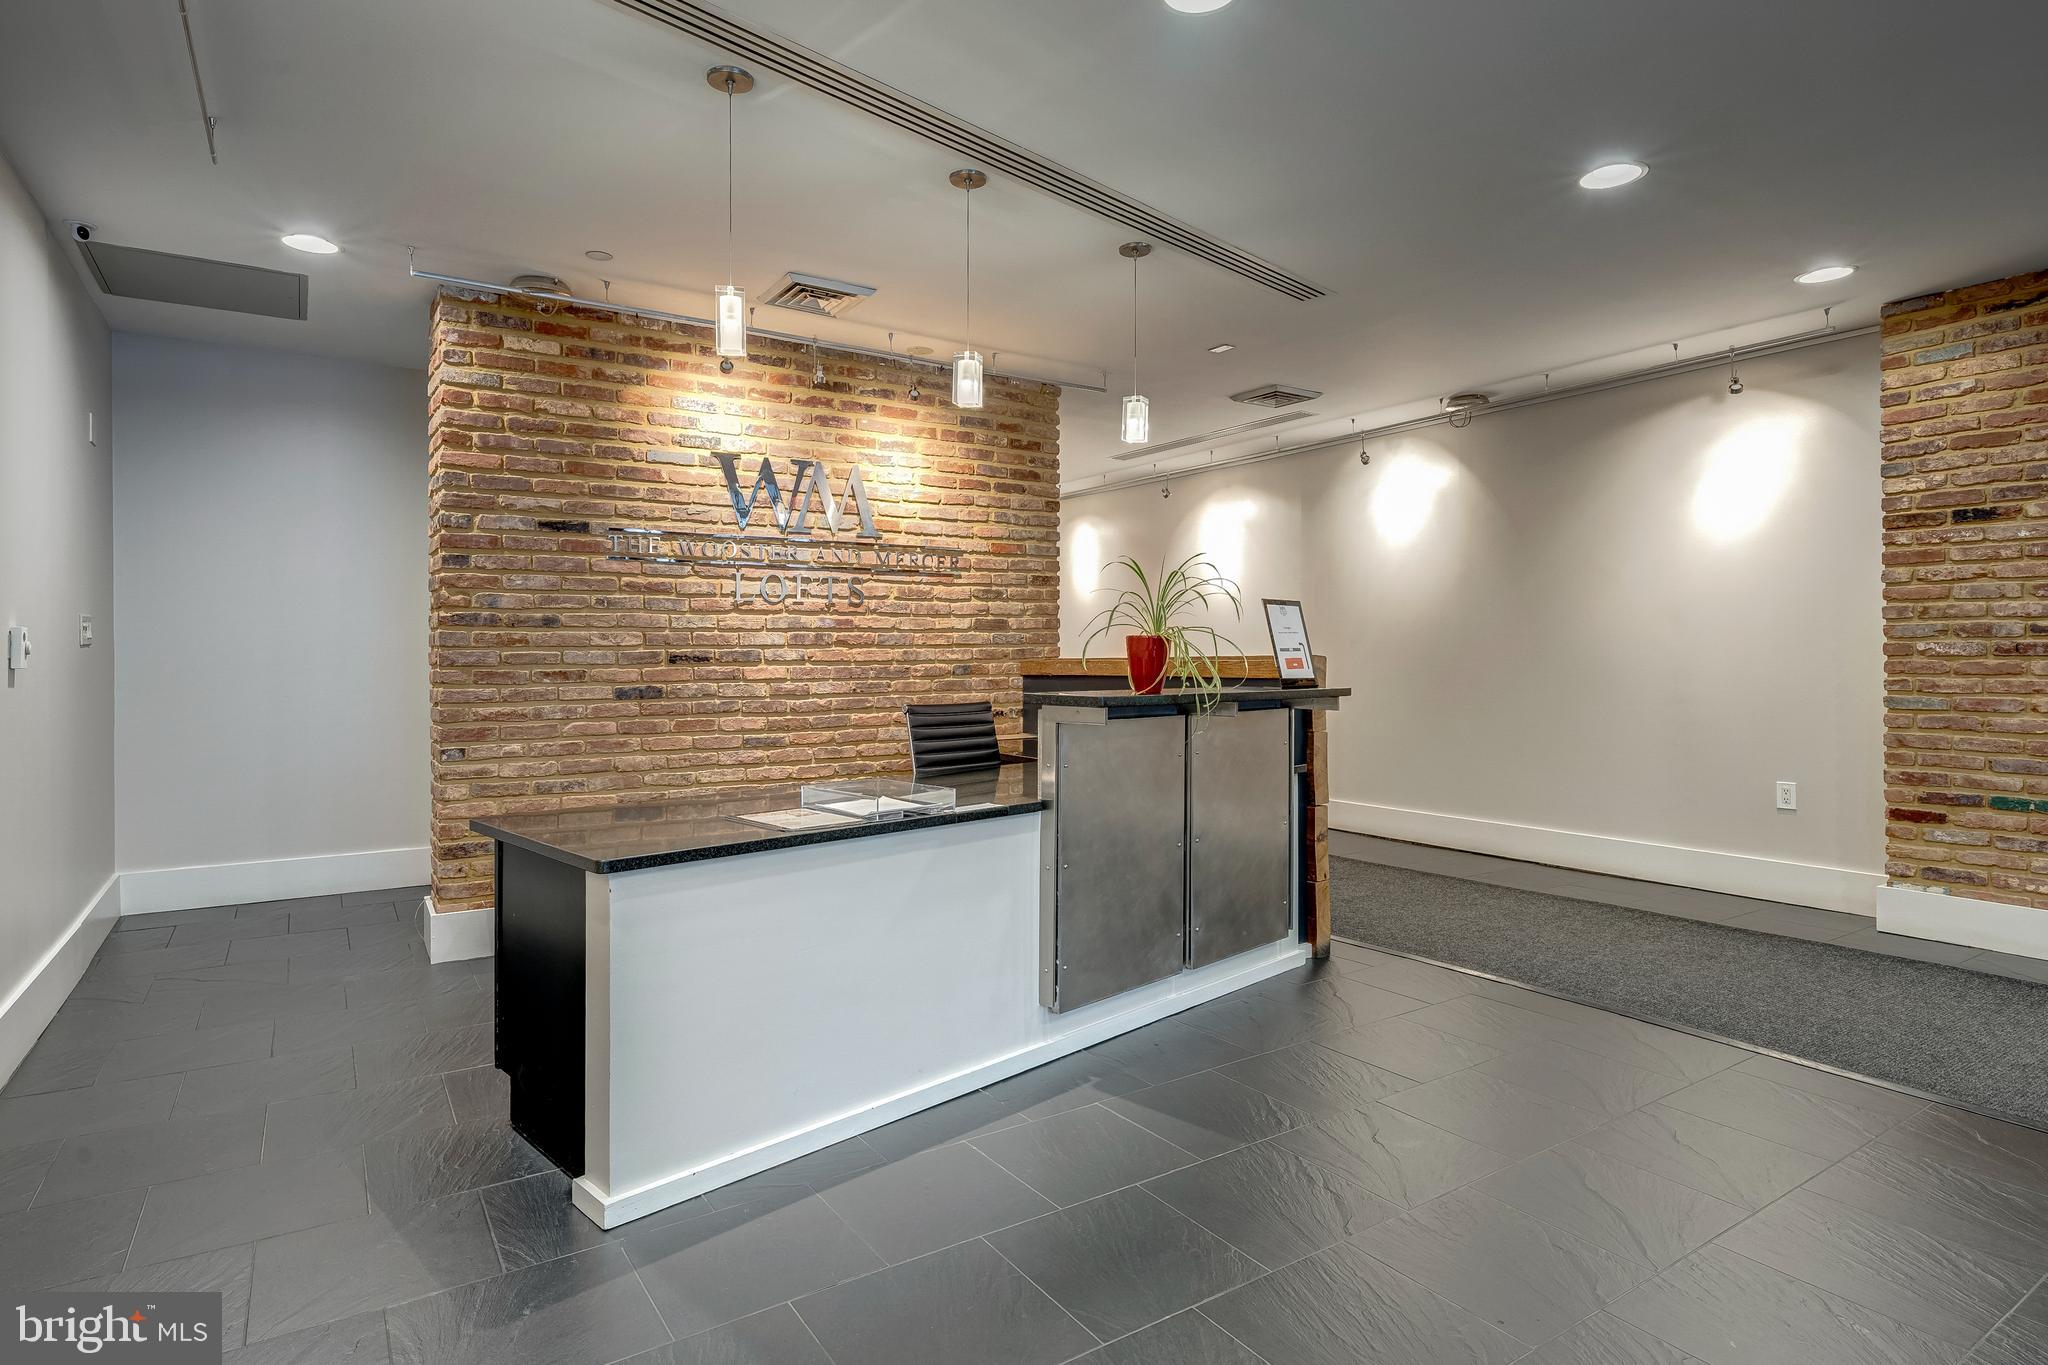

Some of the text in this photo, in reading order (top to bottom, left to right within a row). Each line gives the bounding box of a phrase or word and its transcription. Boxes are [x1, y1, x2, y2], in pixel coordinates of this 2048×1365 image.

[711, 451, 882, 539] WM
[608, 534, 960, 570] THE WOOSTER AND MERCER
[733, 571, 865, 607] LOFTS
